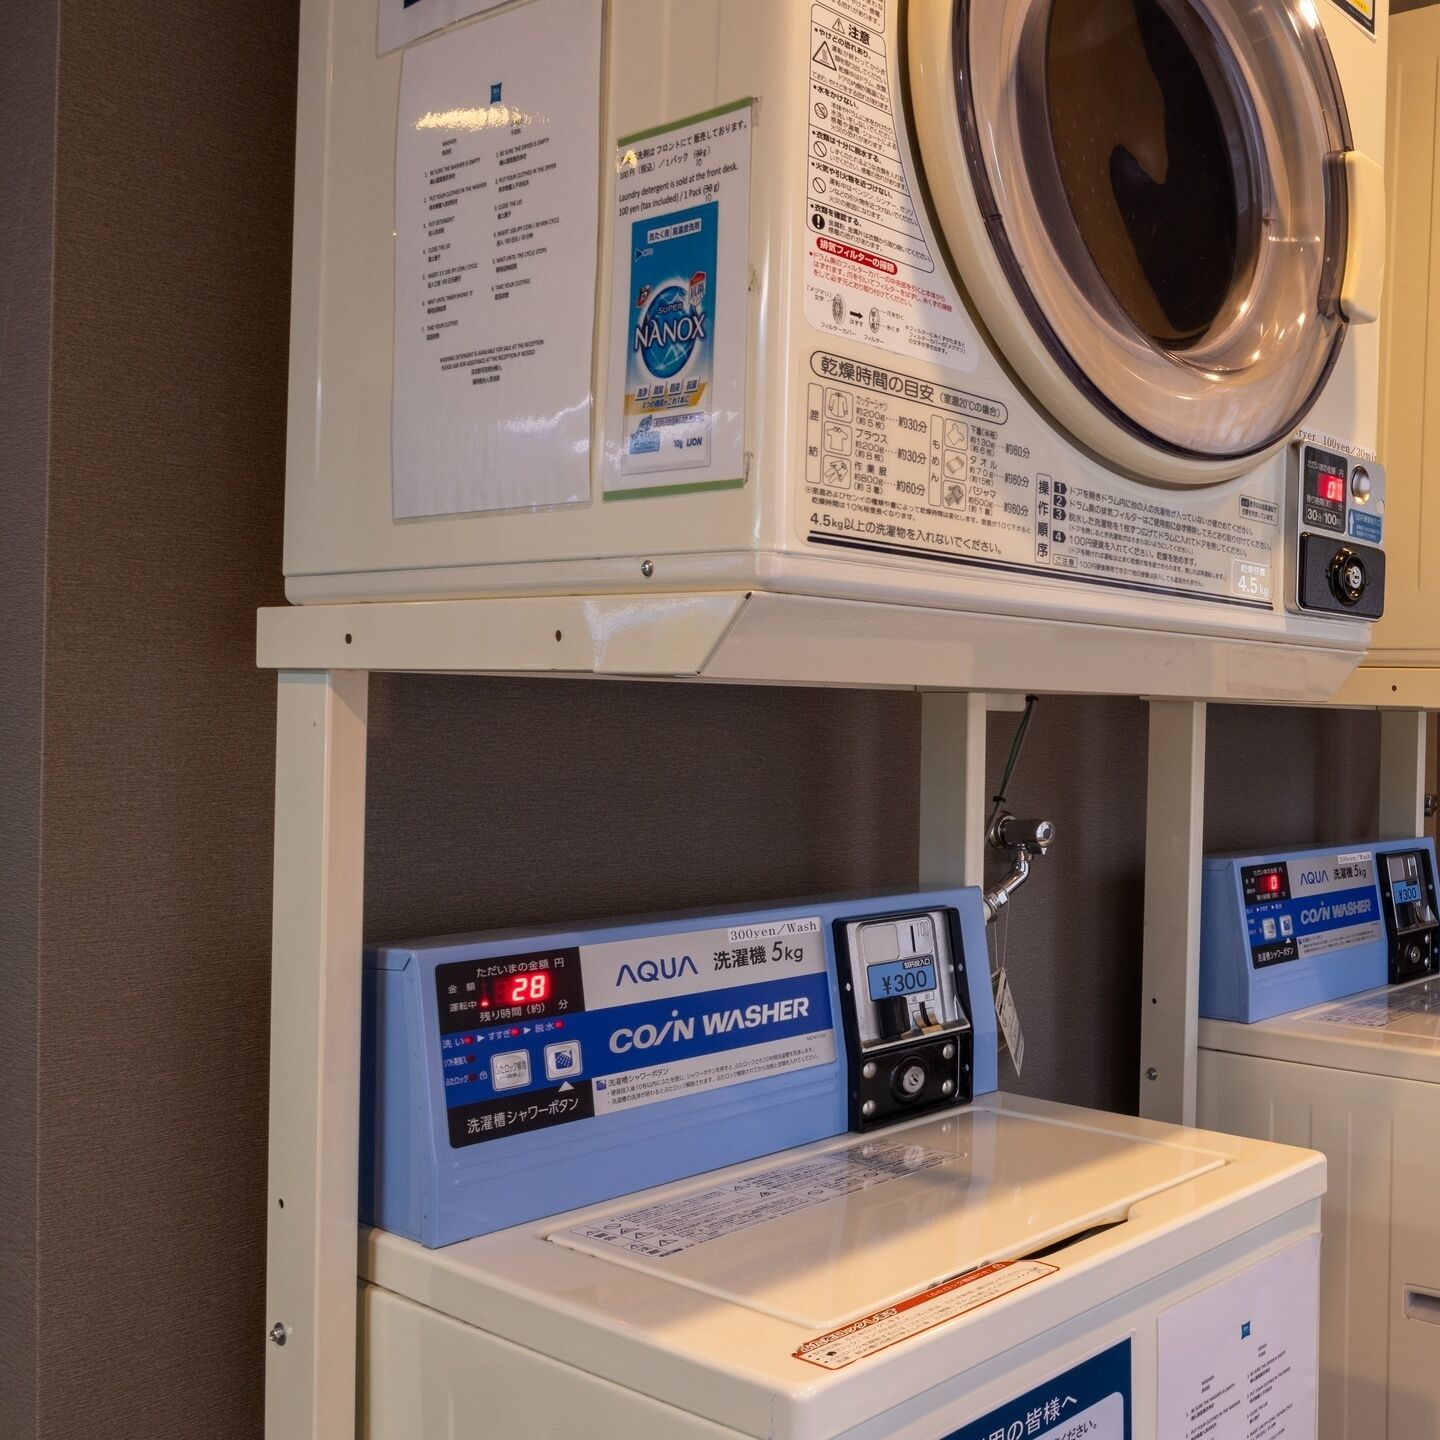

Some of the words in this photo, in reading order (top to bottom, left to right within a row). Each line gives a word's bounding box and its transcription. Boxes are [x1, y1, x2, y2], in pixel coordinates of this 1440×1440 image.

[848, 24, 870, 45] 注意
[619, 189, 640, 203] Laundry
[641, 181, 669, 198] detergent
[670, 180, 675, 188] is
[676, 175, 688, 188] sold
[689, 175, 695, 184] at
[695, 171, 706, 183] the
[706, 166, 722, 180] front
[722, 162, 738, 175] desk.
[619, 207, 629, 217] 100
[629, 204, 640, 216] yen
[641, 201, 652, 213] (tax
[652, 193, 679, 209] included)
[688, 187, 702, 198] Pack
[657, 302, 684, 314] SUPER
[634, 313, 706, 351] NANOX
[820, 355, 935, 404] 乾燥時間の目安
[898, 415, 928, 434] 約30分
[686, 437, 703, 447] LION
[855, 428, 888, 444] ブラウス
[897, 447, 927, 465] 約30分
[1005, 443, 1031, 459] 約60分
[896, 480, 926, 497] 約60分
[1004, 472, 1030, 488] 約60分
[1328, 481, 1335, 499] 0
[1003, 502, 1029, 517] 約60分
[809, 513, 1002, 555] 4.5kg以上の洗濯物を入れないでください。
[1238, 575, 1258, 593] 4.5
[1259, 584, 1269, 597] kg
[1271, 876, 1278, 890] 0
[1300, 869, 1329, 886] AQUA
[1333, 866, 1353, 880] 洗濯機
[1354, 864, 1367, 878] 5kg
[1332, 898, 1372, 920] WASHER
[730, 920, 817, 942] 300yen/Wash
[476, 958, 550, 979] ただいまの金額
[554, 957, 565, 969] 円
[615, 955, 699, 988] AQUA
[713, 946, 767, 971] 洗濯機
[771, 940, 804, 963] 5kg
[511, 974, 546, 1002] 28
[881, 969, 928, 994] ¥300
[449, 1000, 478, 1013] 運転中
[558, 999, 569, 1010] 分
[702, 996, 810, 1036] WASHER
[487, 1029, 512, 1042] すすぎ
[534, 1021, 555, 1034] 脱水
[606, 1067, 669, 1087] 洗濯槽シャワーボタン
[466, 1096, 580, 1135] 洗濯槽シャワーボタン
